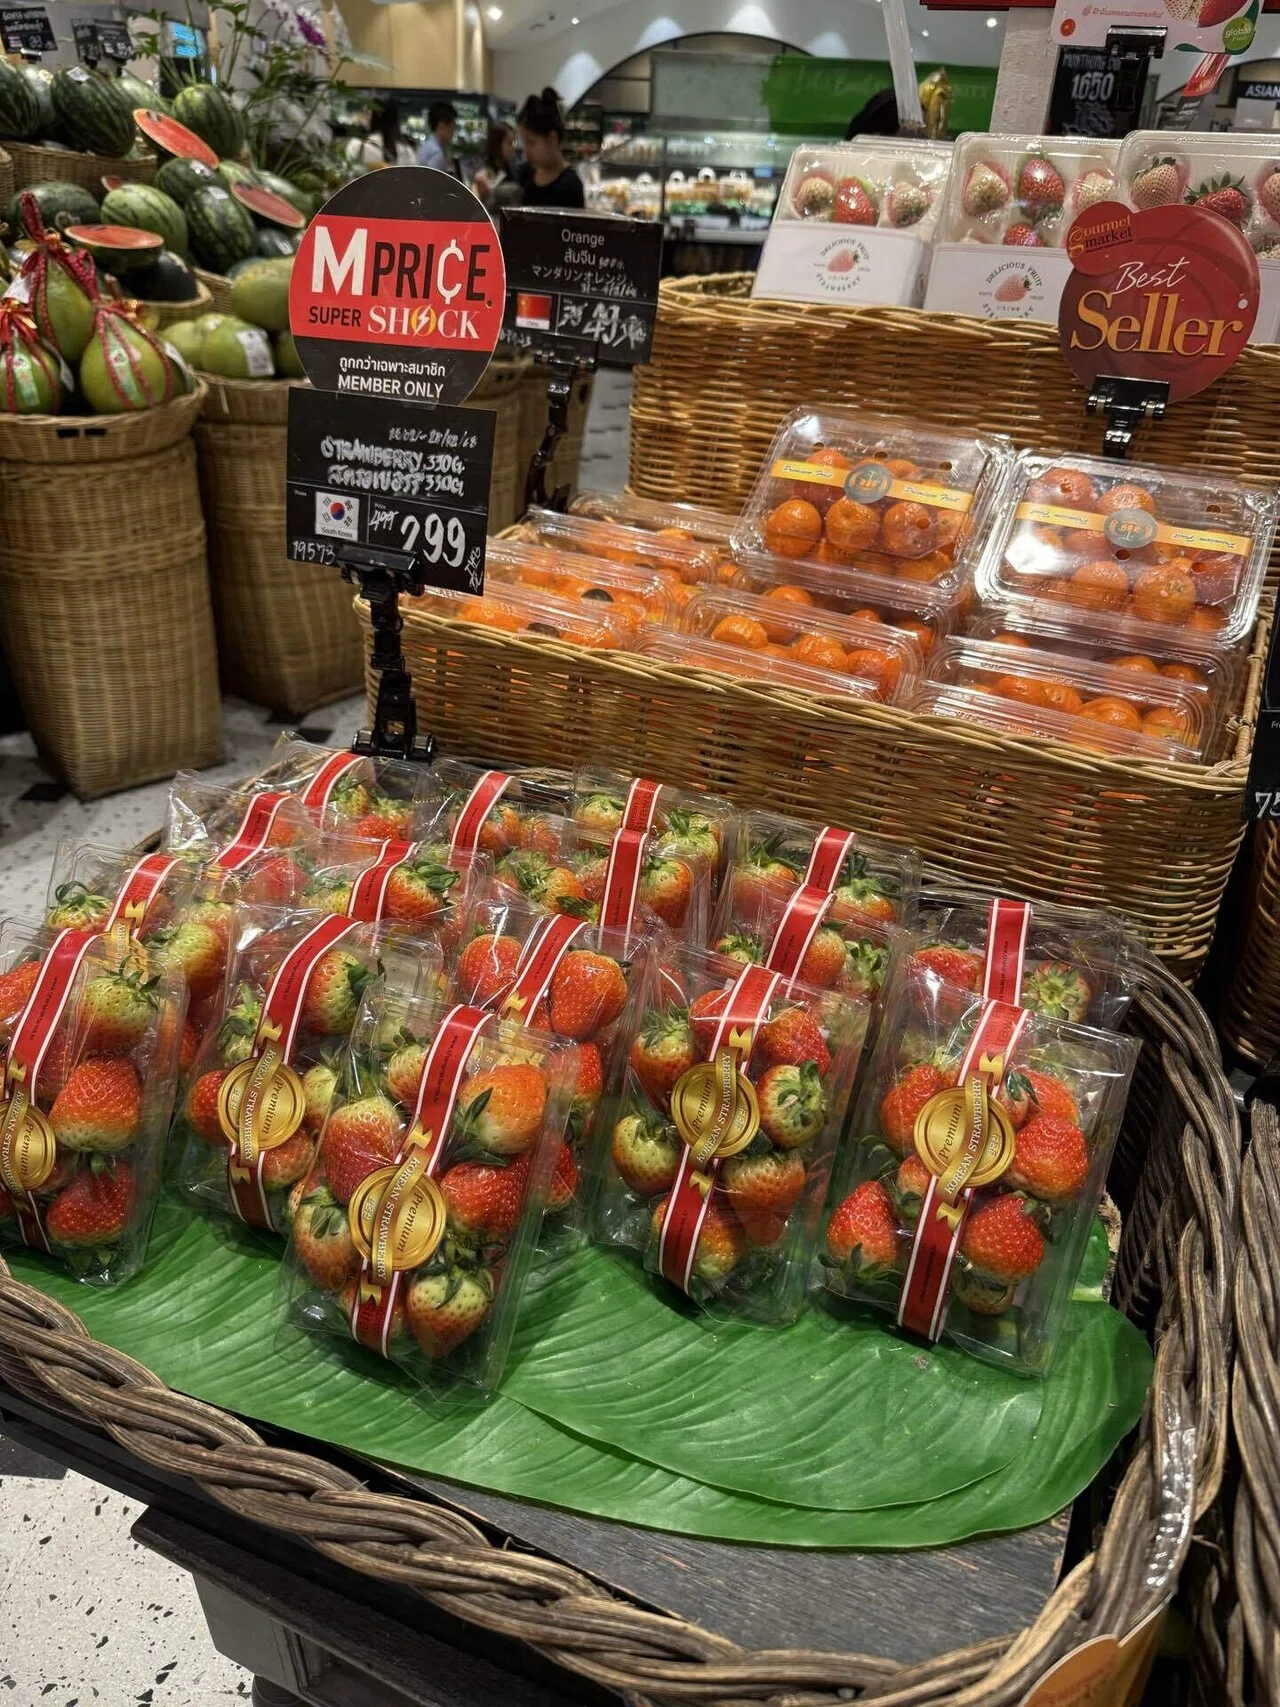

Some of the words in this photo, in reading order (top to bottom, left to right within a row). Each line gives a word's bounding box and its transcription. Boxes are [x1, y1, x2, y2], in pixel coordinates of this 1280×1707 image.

[561, 228, 605, 248] Orange
[1069, 215, 1132, 258] Gourmet
[1085, 227, 1133, 251] market
[531, 265, 629, 286] マンダリンオレンジ
[986, 261, 1026, 284] DELICIOUS
[1026, 265, 1043, 287] FRUIT
[1114, 256, 1190, 295] Best
[308, 305, 362, 327] SUPER
[367, 304, 481, 339] SHOCK
[1070, 290, 1244, 356] Seller
[337, 374, 401, 395] MEMBER
[404, 380, 444, 399] ONLY
[339, 355, 446, 377] ถูกกว่าเฉพาะสมาชิก
[904, 486, 937, 498] Premium
[321, 526, 338, 536] South
[337, 529, 353, 539] Korea
[253, 1050, 277, 1089] KOREAN
[8, 1090, 24, 1131] KOREAN
[262, 1080, 283, 1135] Premium
[692, 1078, 713, 1131] Premium
[697, 1125, 722, 1165] KOREAN
[718, 1053, 731, 1125] STRAWBERRY
[243, 1090, 259, 1162] STRAWBERRY
[938, 1102, 963, 1160] Premium
[944, 1155, 973, 1195] KOREAN
[968, 1077, 982, 1153] STRAWBERRY
[20, 1120, 35, 1176] Premium
[389, 1158, 420, 1204] KOREAN
[375, 1202, 397, 1280] STRAWBERRY
[397, 1193, 424, 1253] Premium
